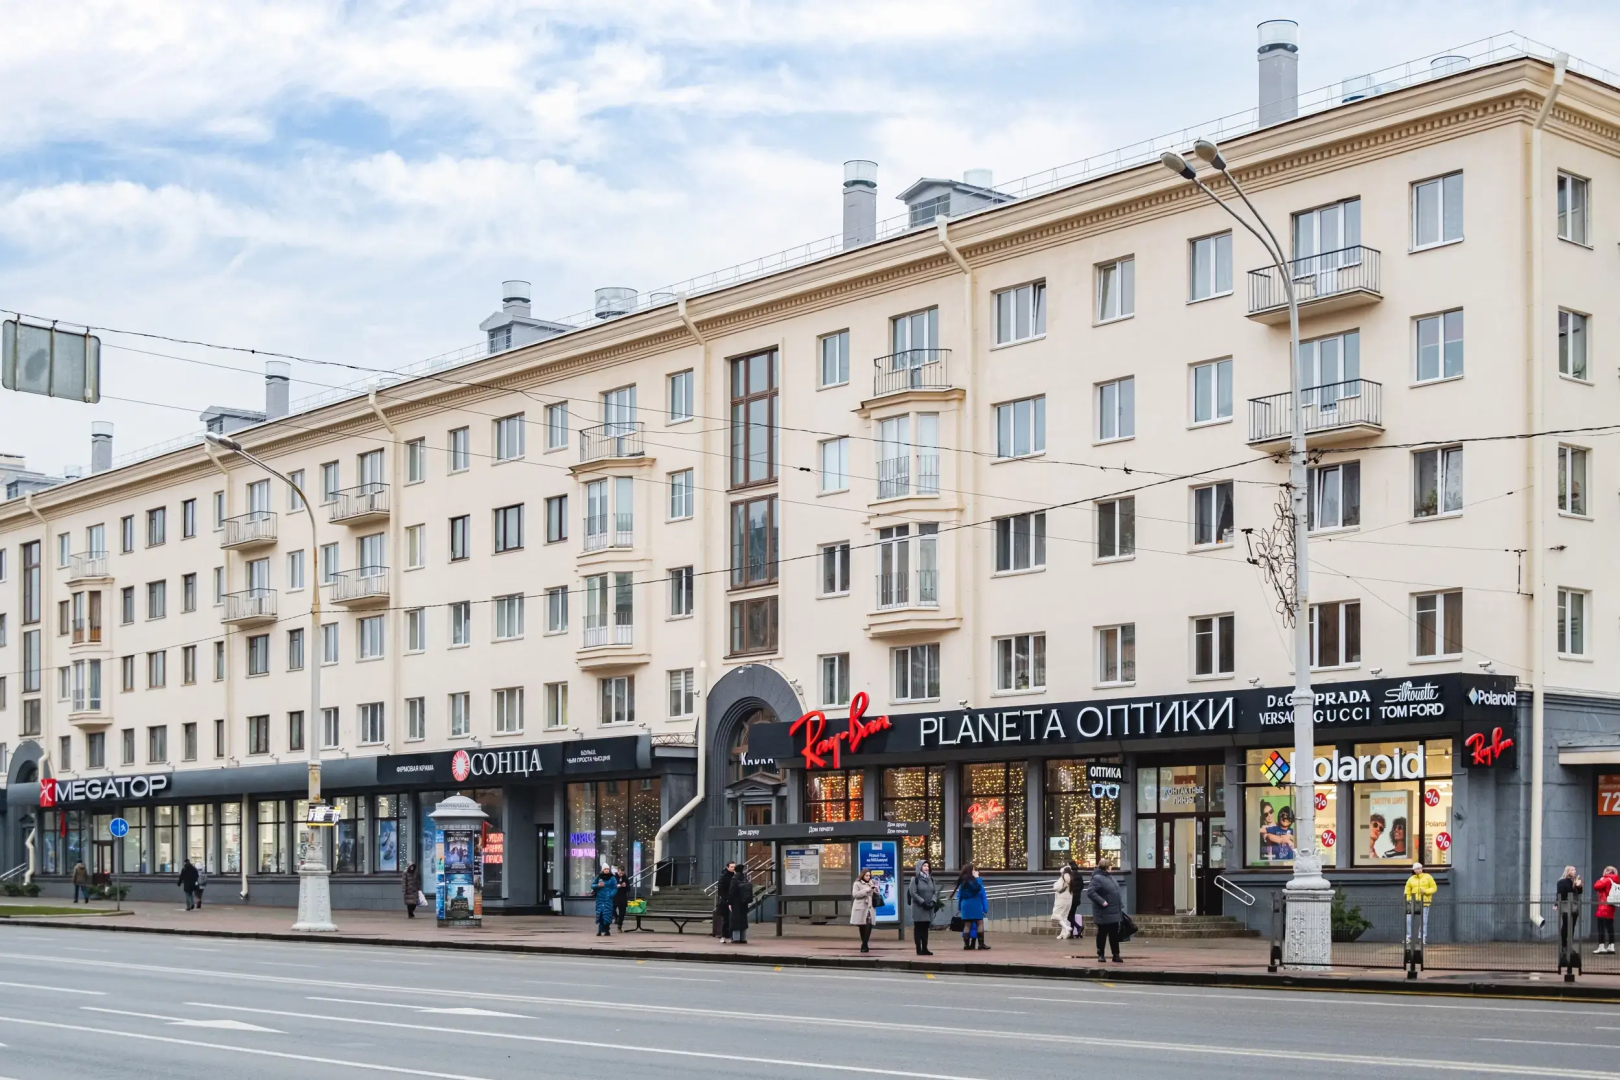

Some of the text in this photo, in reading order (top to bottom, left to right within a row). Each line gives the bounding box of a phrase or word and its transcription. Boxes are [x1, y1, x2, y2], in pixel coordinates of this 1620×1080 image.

[1314, 690, 1371, 705] PRADA
[1384, 681, 1439, 703] Silhouette
[1478, 689, 1517, 706] Polaroid
[1259, 707, 1370, 725] VERSA GUCCI
[1379, 702, 1445, 719] TOM FORD
[920, 696, 1234, 746] PLANETA ОПТИКИ
[470, 748, 543, 777] СОНЦА
[1090, 766, 1122, 779] ОПТИКА
[55, 775, 167, 802] MEGATOP
[1164, 786, 1204, 796] КОНТАКТНЫЕ
[1173, 796, 1196, 805] ЛИНЗЫ
[809, 826, 818, 834] Дом
